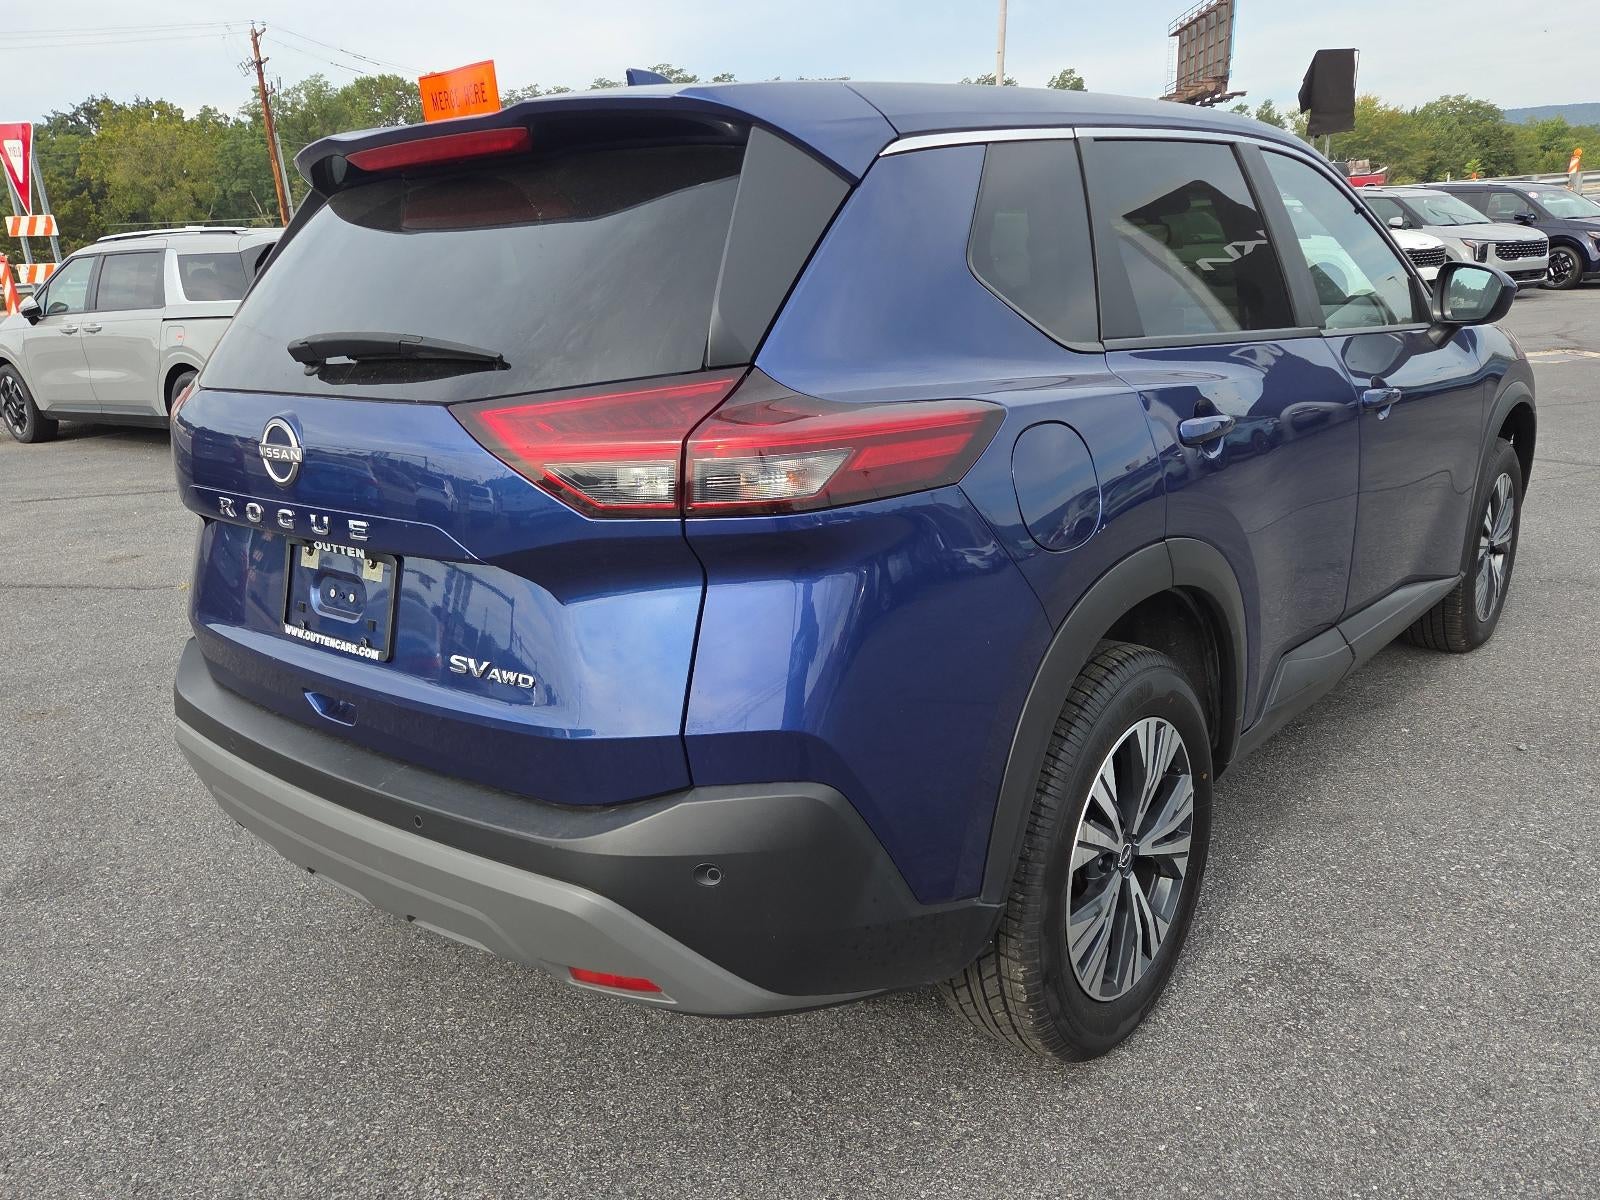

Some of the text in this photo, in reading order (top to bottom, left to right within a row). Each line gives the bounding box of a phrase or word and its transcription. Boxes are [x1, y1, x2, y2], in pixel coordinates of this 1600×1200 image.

[464, 82, 488, 107] HERE
[259, 446, 300, 461] NISSAN
[219, 496, 370, 541] ROGUE
[313, 541, 366, 559] OUTTEN
[284, 623, 379, 661] WWW.OUTTENCARS.COM
[449, 654, 535, 689] SV AWD
